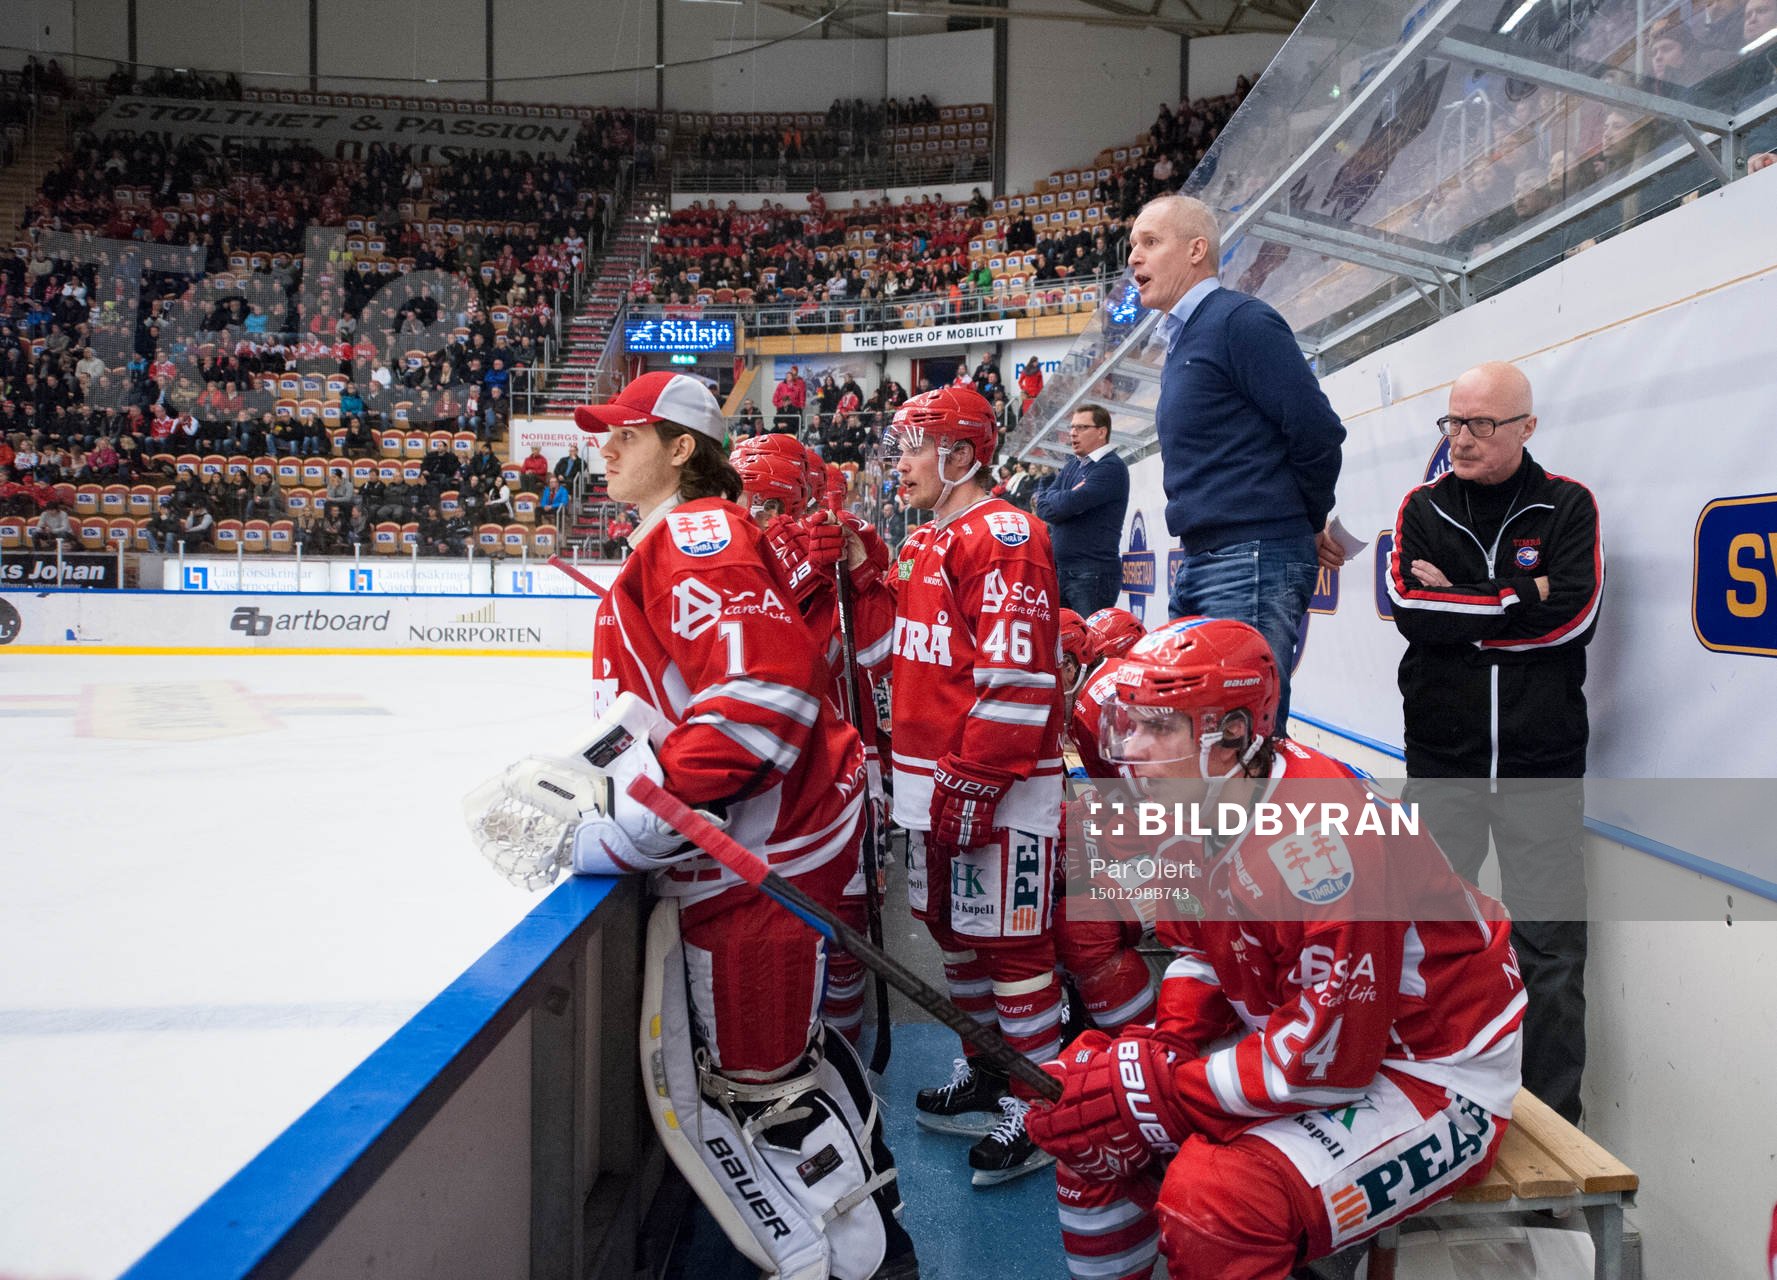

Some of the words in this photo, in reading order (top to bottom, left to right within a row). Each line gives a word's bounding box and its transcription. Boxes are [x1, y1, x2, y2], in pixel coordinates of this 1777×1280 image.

[113, 102, 339, 129] STOLTHET
[350, 114, 384, 131] &
[394, 115, 570, 143] PASSION
[660, 320, 731, 348] Sidsjö
[854, 336, 878, 348] THE
[882, 332, 923, 347] POWER
[927, 330, 943, 342] OF
[947, 325, 1004, 340] MOBILITY
[521, 433, 578, 441] NORBERGS
[28, 561, 105, 580] Johan
[1726, 532, 1777, 618] S
[1011, 581, 1051, 608] SCA
[275, 608, 390, 632] artboard
[409, 625, 542, 643] NORRPORTEN
[717, 621, 747, 677] 1
[982, 619, 1033, 665] 46
[1223, 677, 1261, 688] BAUER
[961, 902, 994, 915] Kapell
[1272, 990, 1345, 1080] 24
[1117, 1040, 1180, 1154] BAUER
[1294, 1113, 1345, 1160] Kapell
[705, 1137, 792, 1242] BAUER
